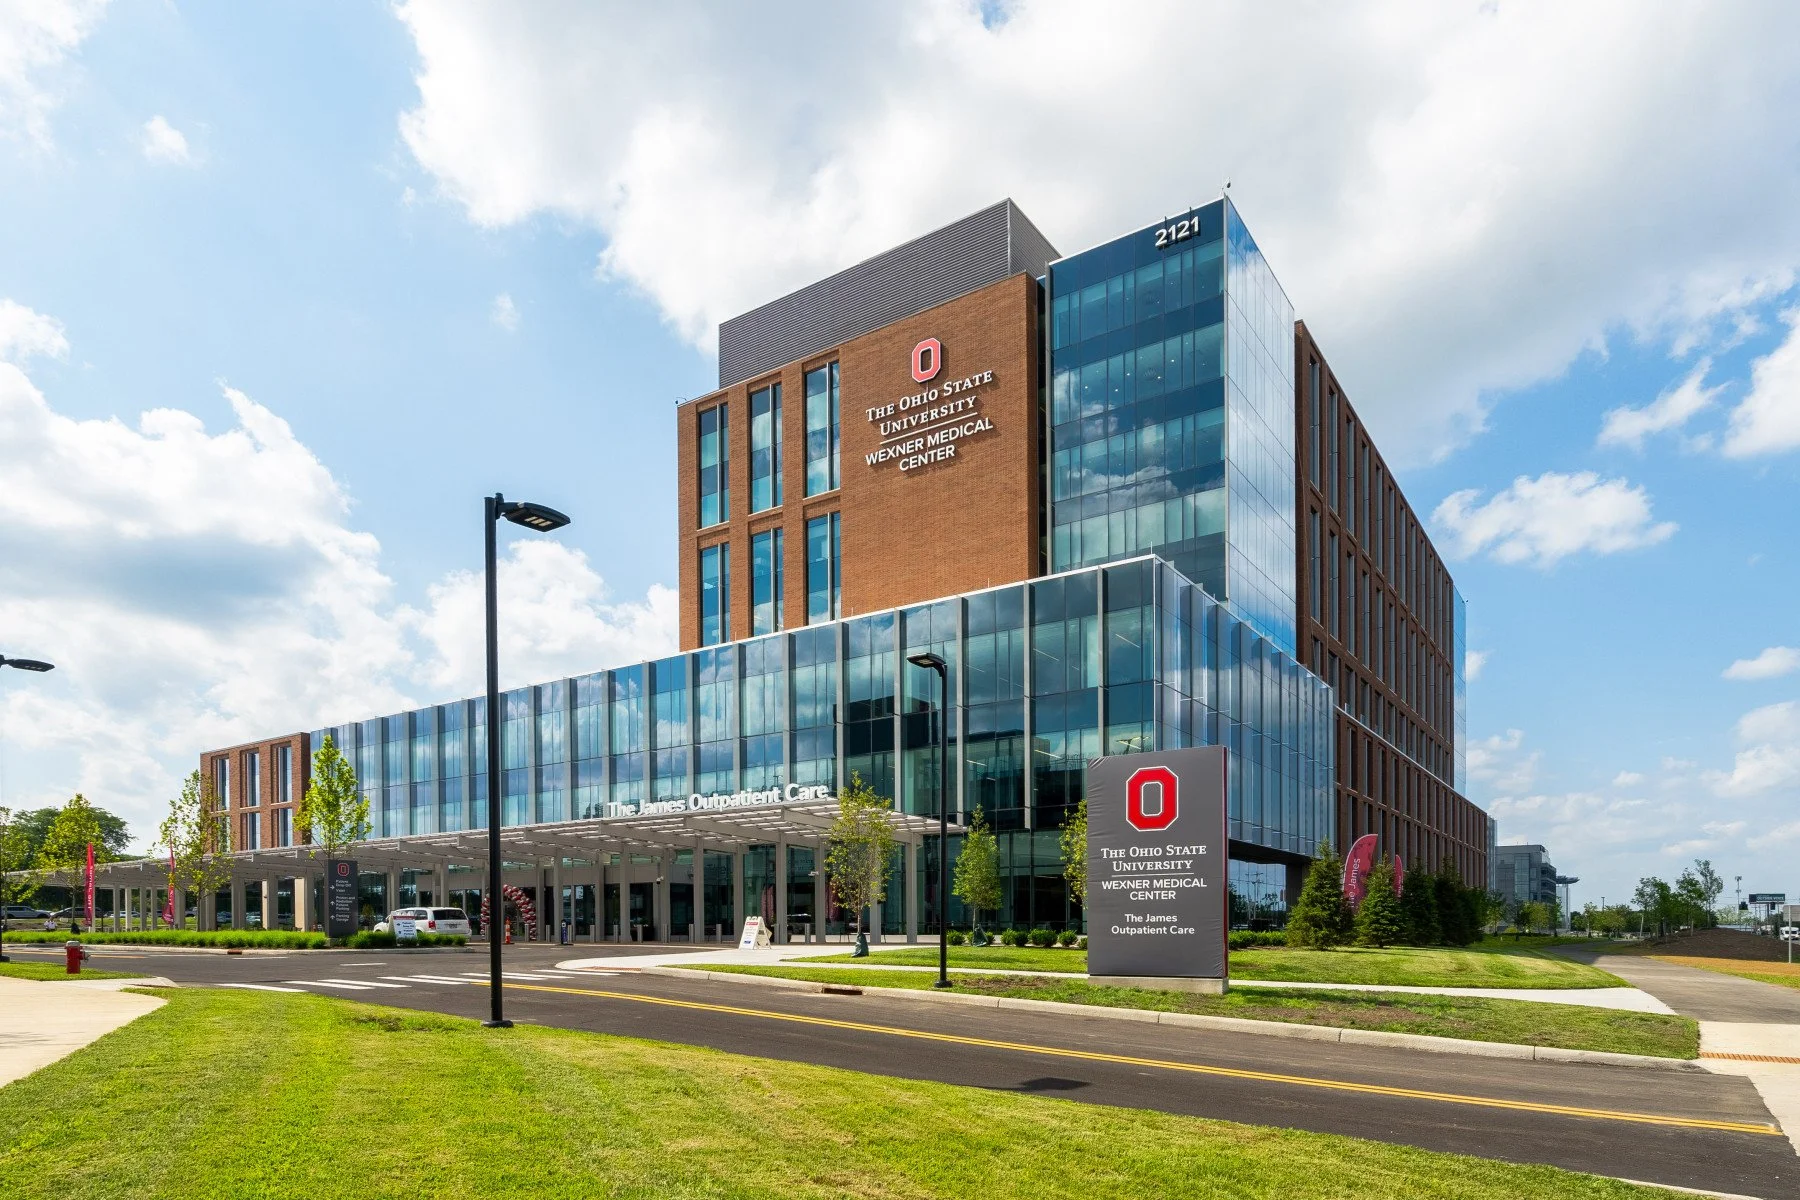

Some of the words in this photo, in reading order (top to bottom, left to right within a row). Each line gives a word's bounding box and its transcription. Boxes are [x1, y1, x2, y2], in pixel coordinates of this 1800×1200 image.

[1155, 216, 1199, 247] 2121
[911, 337, 941, 383] O
[866, 403, 895, 422] THE
[900, 389, 938, 411] OHIO
[943, 370, 993, 397] STATE
[879, 395, 977, 436] UNIVERSITY
[865, 437, 924, 466] WEXNER
[927, 417, 994, 448] MEDICAL
[899, 444, 956, 472] CENTER
[607, 800, 636, 818] The
[637, 798, 687, 816] James
[688, 786, 782, 812] Outpatient
[784, 783, 829, 802] Care
[1126, 765, 1179, 832] O
[1100, 847, 1126, 859] THE
[1129, 846, 1163, 858] OHIO
[1166, 844, 1207, 856] STATE
[1112, 859, 1194, 872] UNIVERSITY
[1101, 880, 1150, 890] WEXNER
[1153, 878, 1208, 889] MEDICAL
[1348, 858, 1361, 889] James
[1129, 890, 1176, 901] CENTER
[1111, 925, 1168, 937] Outpatient
[1170, 925, 1195, 935] Care
[1124, 913, 1143, 923] The
[1145, 914, 1178, 923] James
